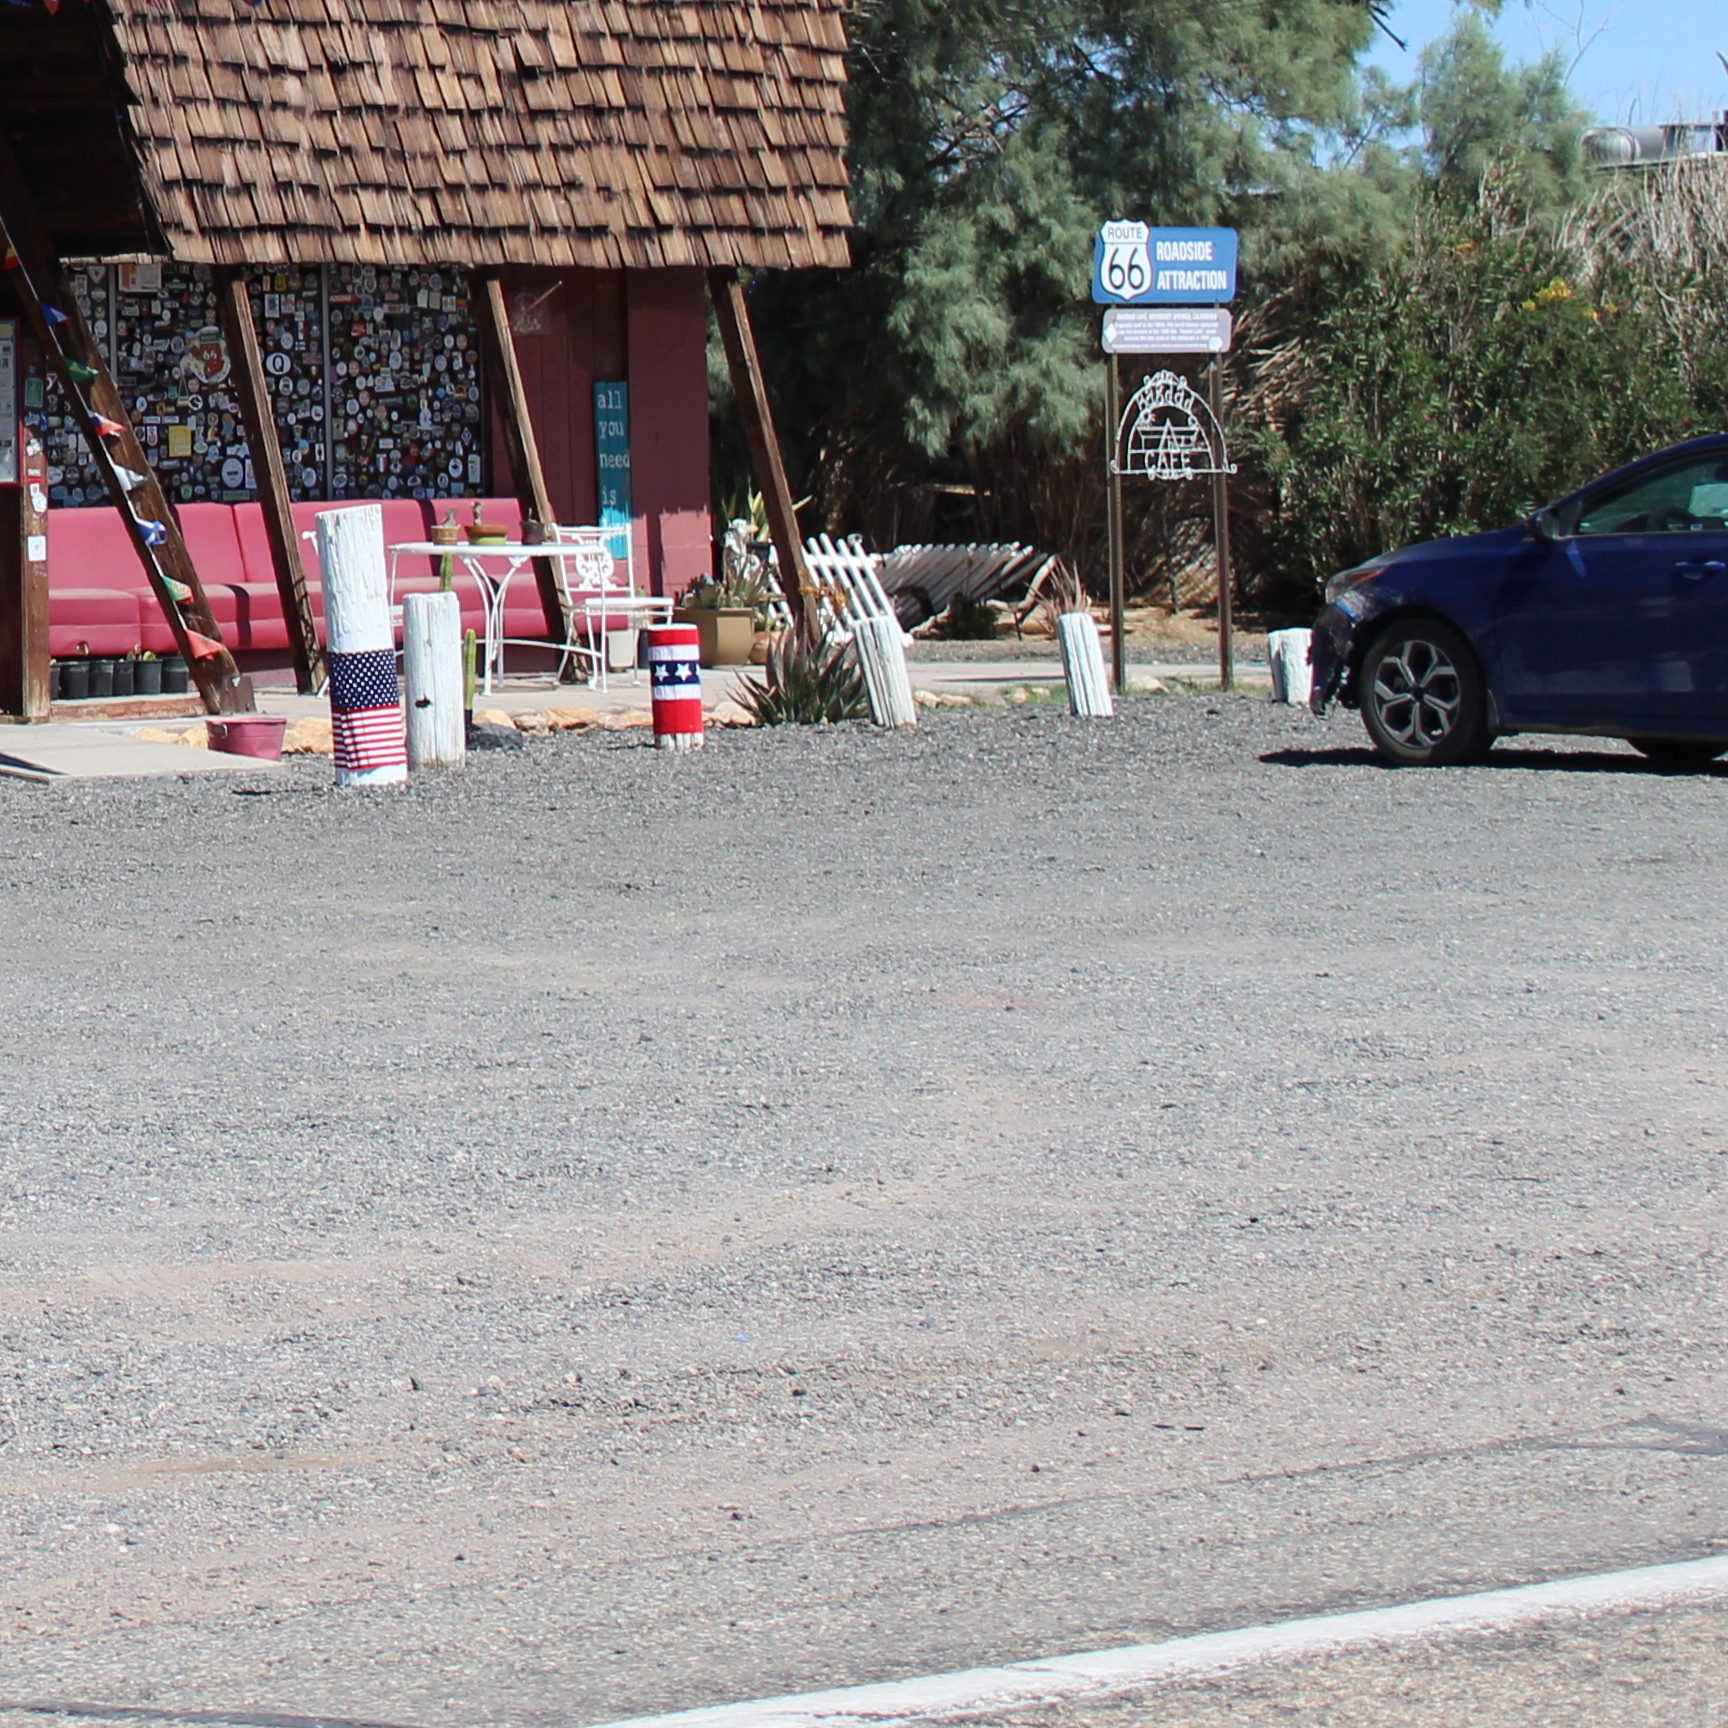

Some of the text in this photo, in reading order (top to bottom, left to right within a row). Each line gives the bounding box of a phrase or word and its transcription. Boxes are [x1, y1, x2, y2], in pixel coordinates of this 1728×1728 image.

[1107, 226, 1143, 239] ROUTE
[1156, 241, 1214, 261] ROADSIDE
[1108, 246, 1145, 290] 66
[1156, 270, 1227, 290] ATTRACTION
[597, 390, 623, 410] all
[598, 421, 626, 439] you
[599, 450, 631, 469] need
[602, 485, 617, 506] is
